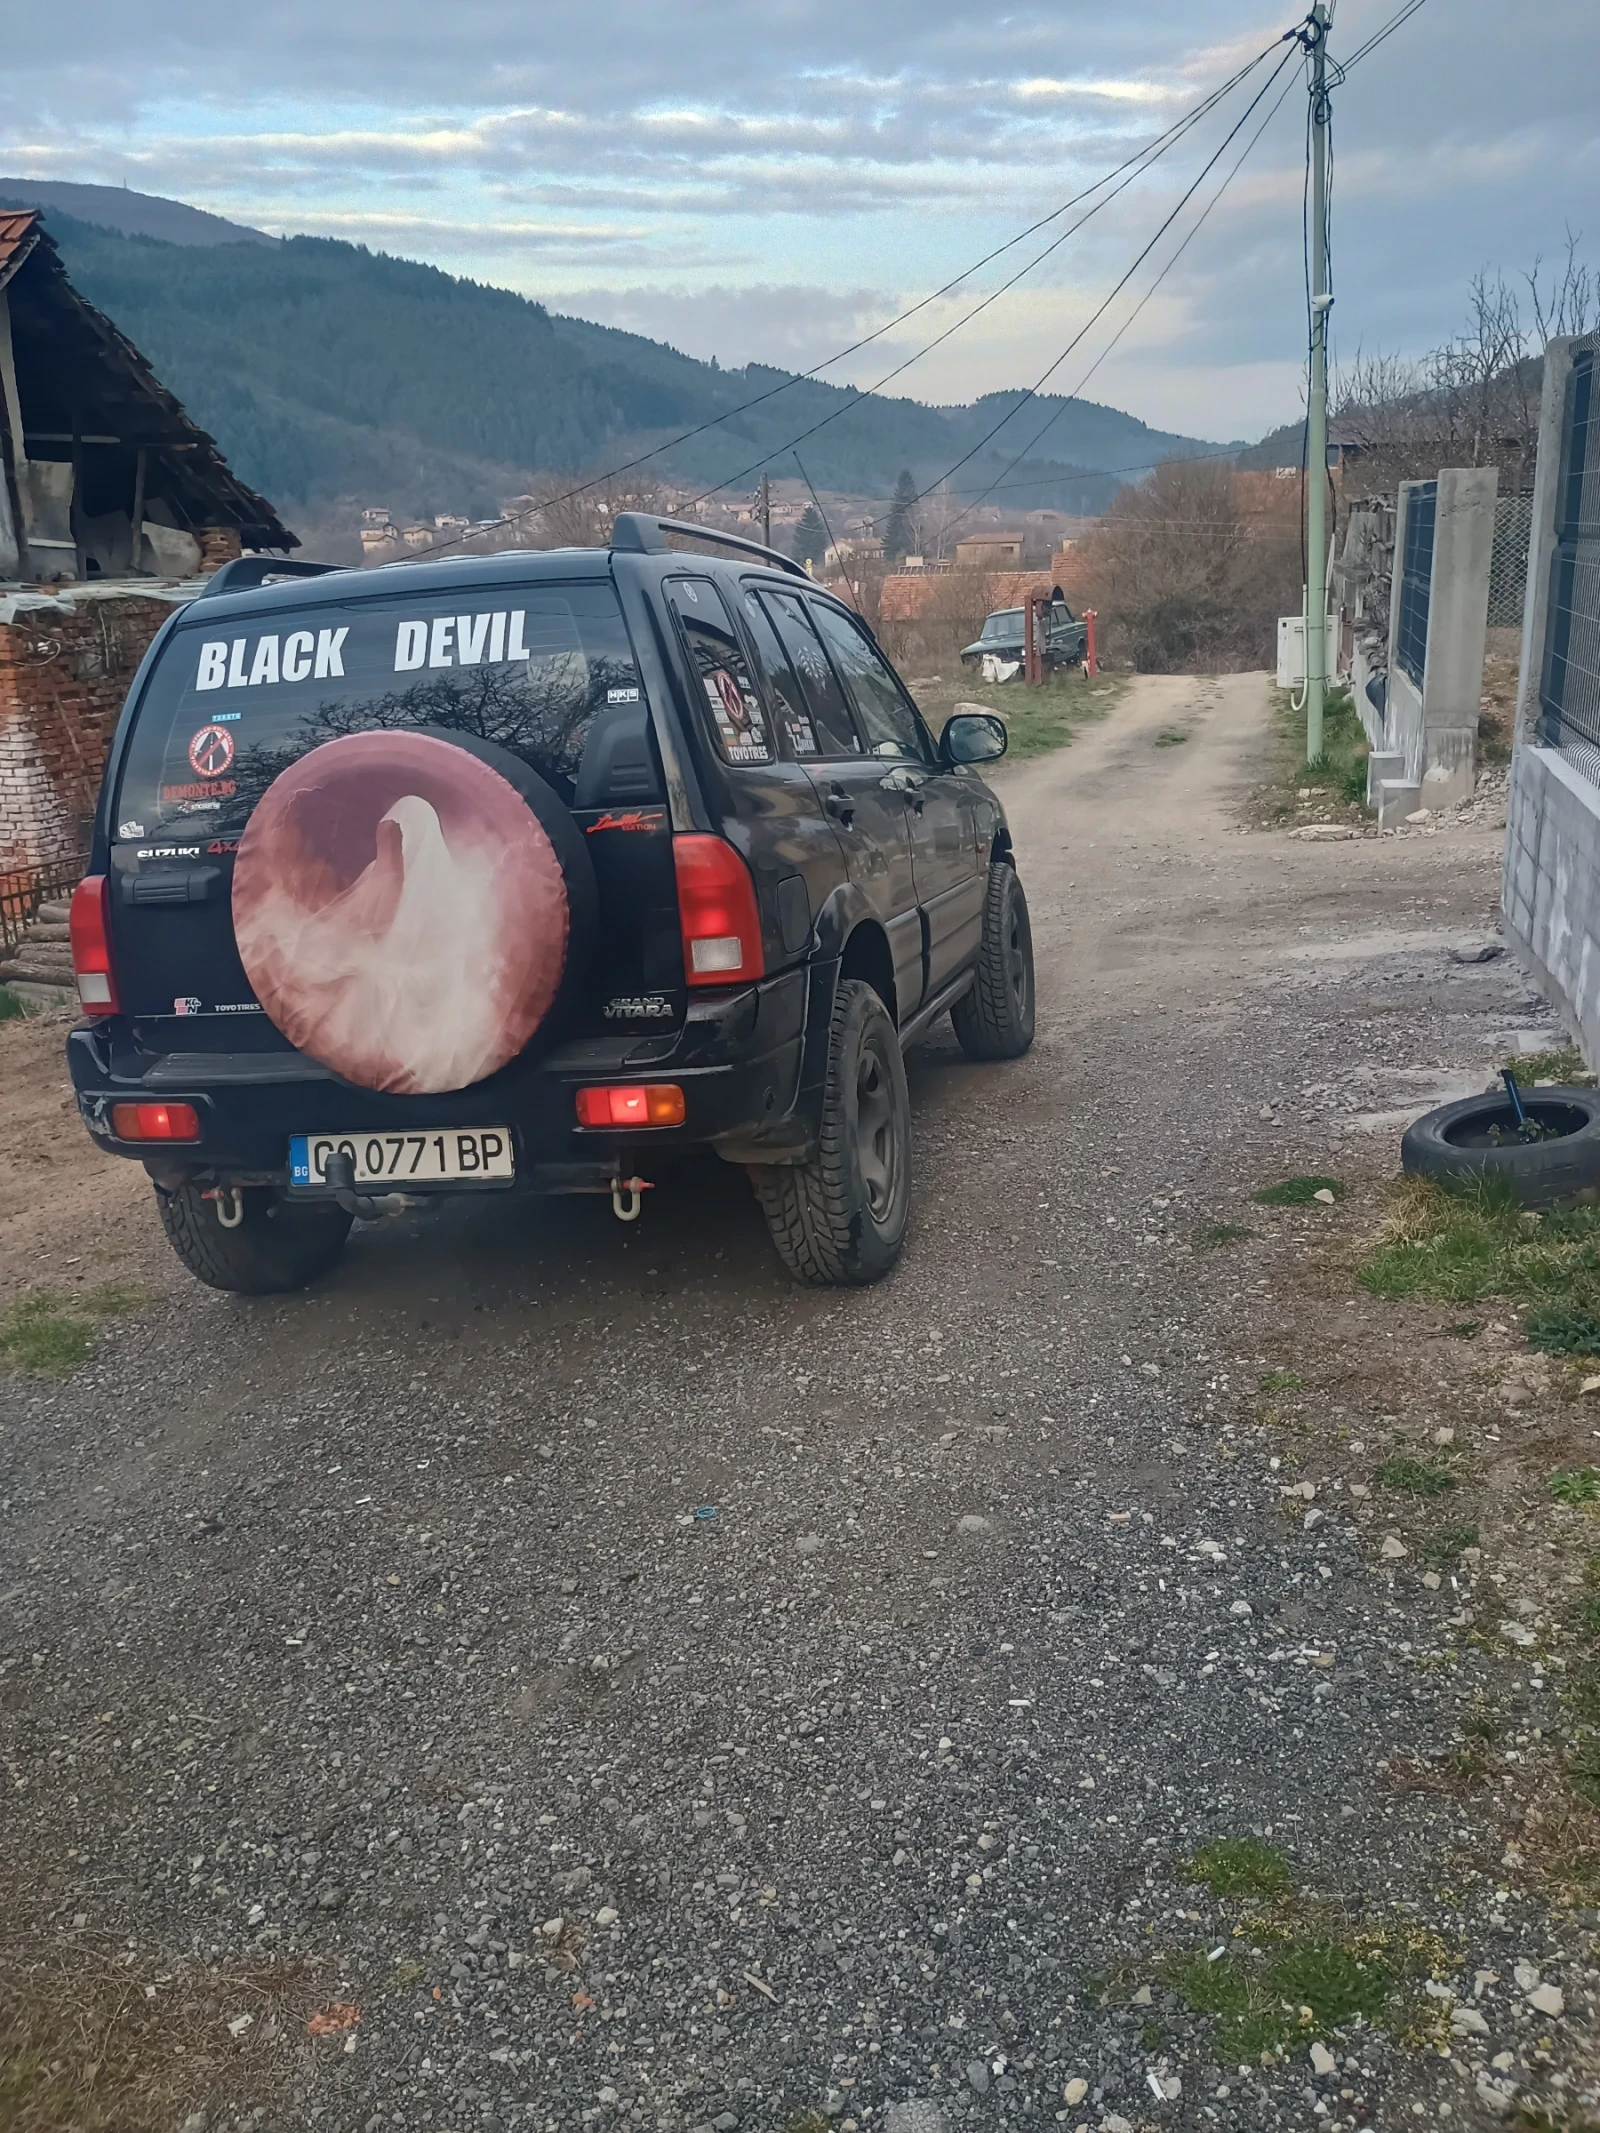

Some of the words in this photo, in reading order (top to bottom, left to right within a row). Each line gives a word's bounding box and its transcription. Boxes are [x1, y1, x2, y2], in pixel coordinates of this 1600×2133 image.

[194, 626, 350, 691] BLACK
[394, 610, 530, 672] DEVIL
[608, 689, 638, 702] HKS
[137, 847, 200, 859] SUZUKI
[609, 997, 665, 1007] GRAND
[602, 1004, 674, 1018] VITARA
[294, 1166, 308, 1177] BG
